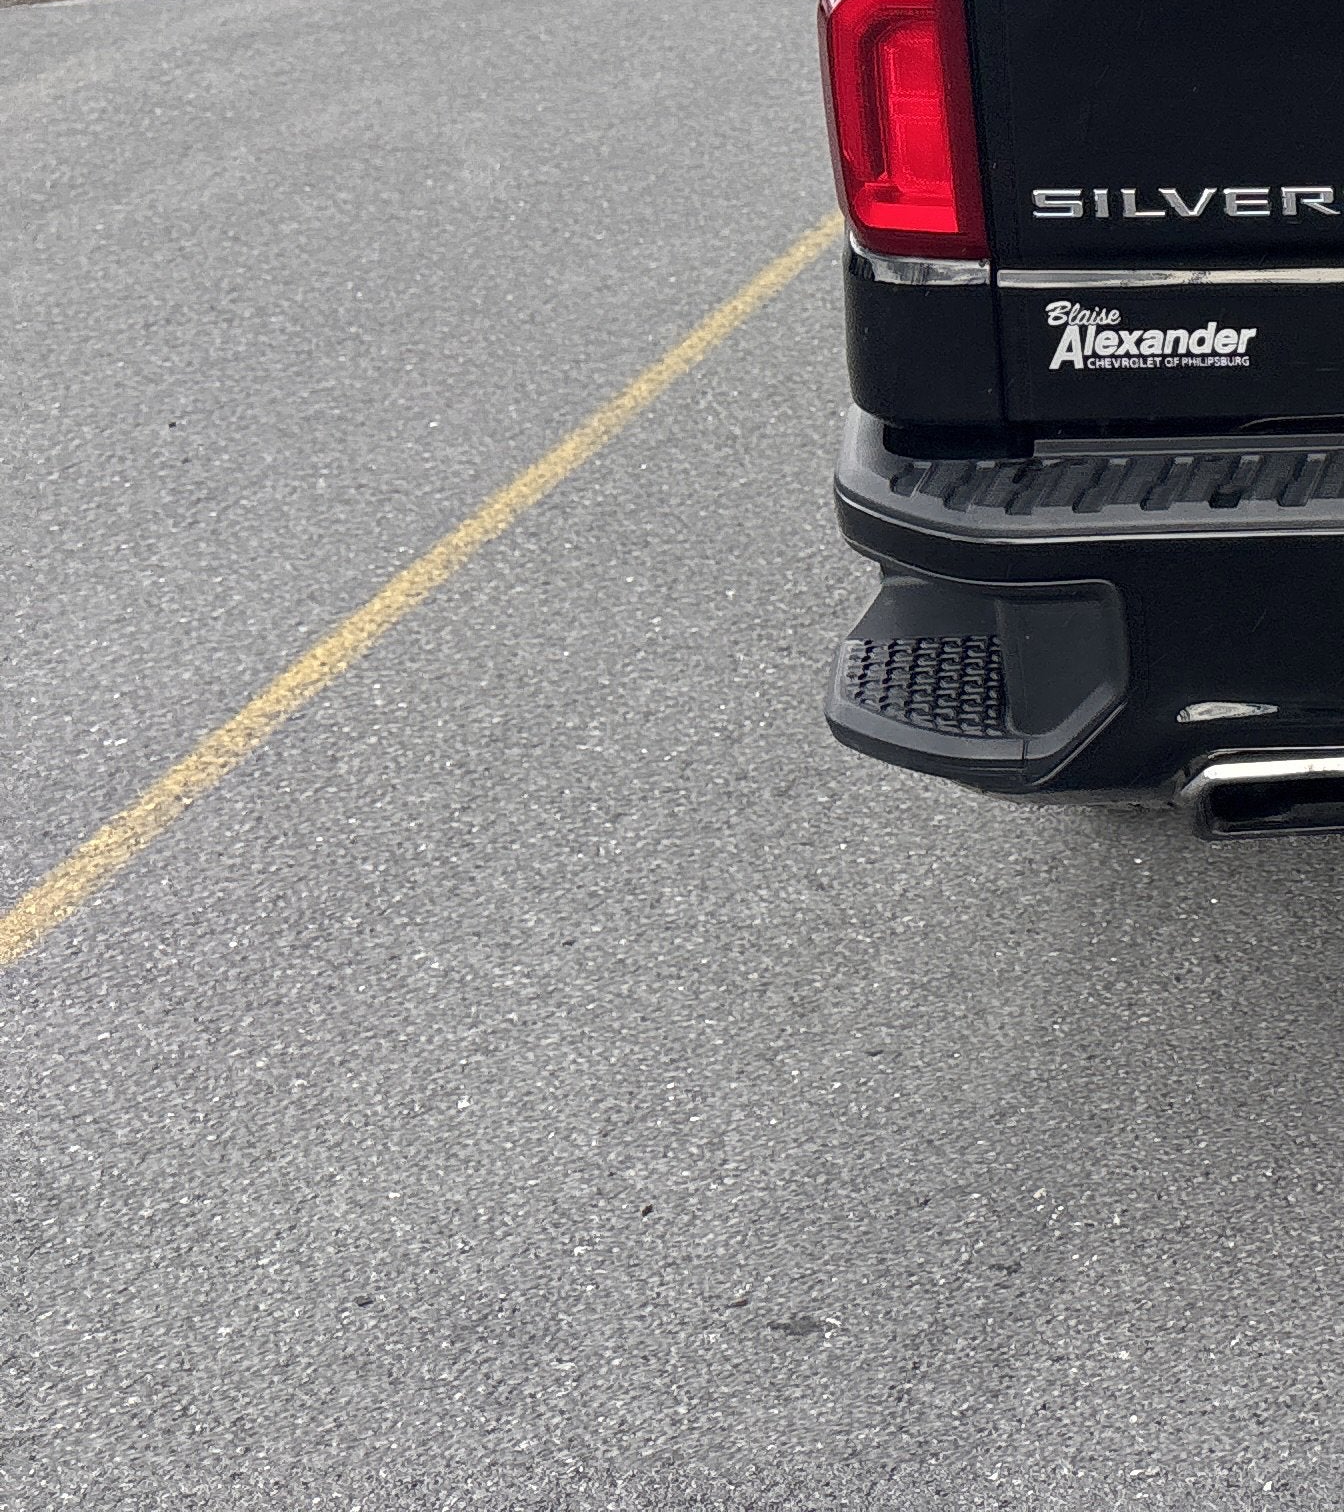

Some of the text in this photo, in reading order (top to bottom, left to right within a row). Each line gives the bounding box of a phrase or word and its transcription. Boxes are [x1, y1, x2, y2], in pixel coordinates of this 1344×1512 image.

[1045, 300, 1122, 326] Blaise
[1049, 321, 1258, 370] Alexander
[1087, 355, 1250, 369] CHEVROLET OF PHILIPSBURG
